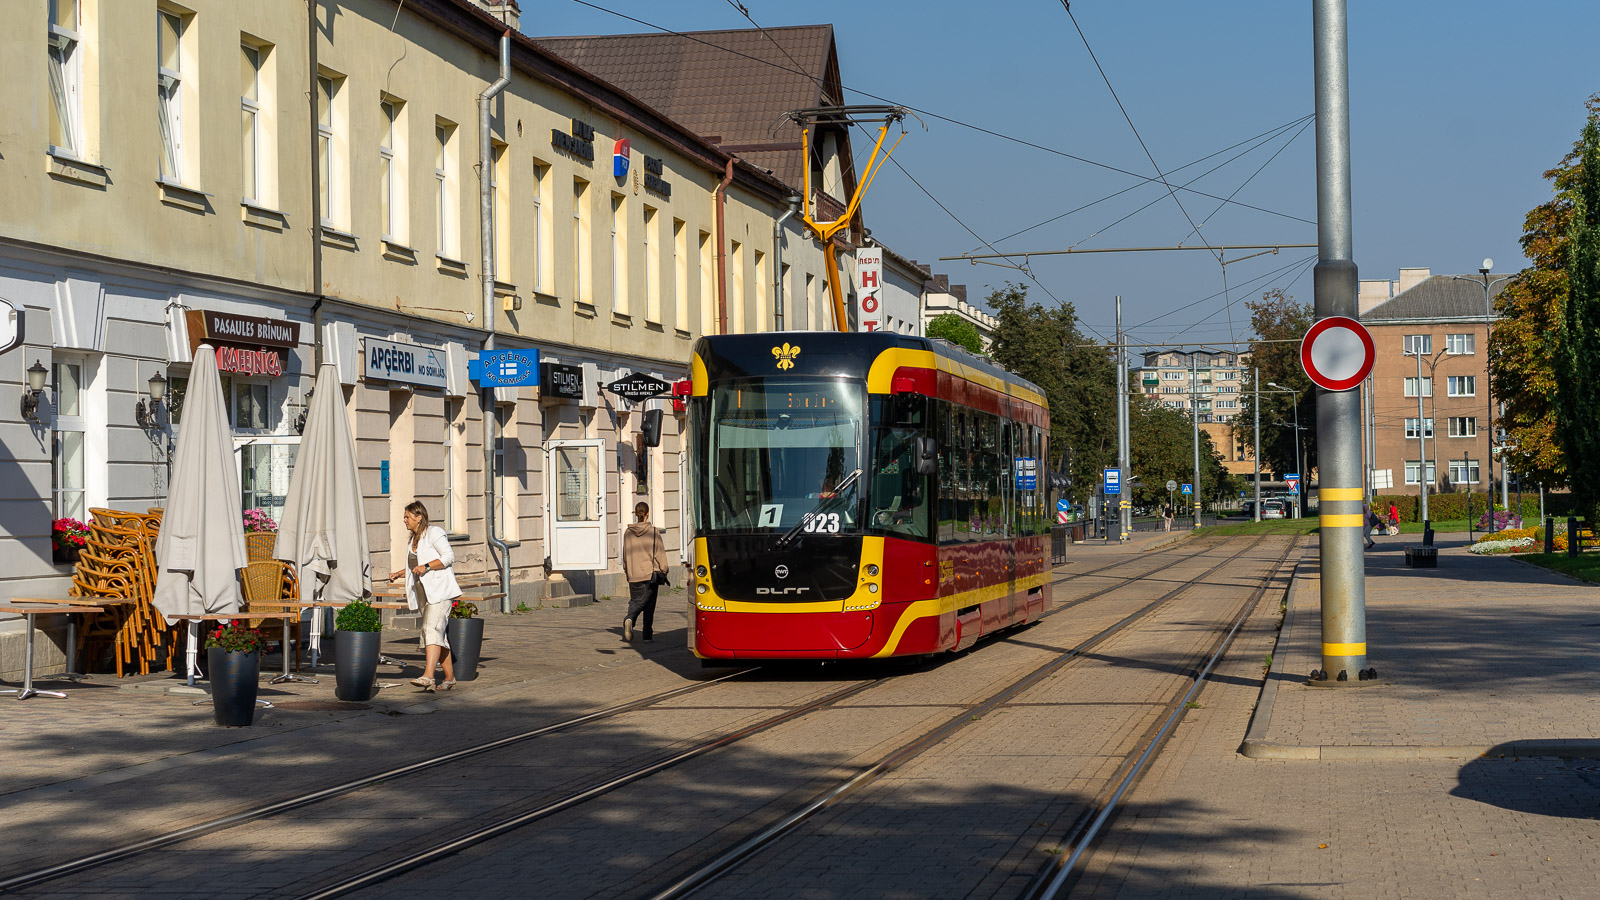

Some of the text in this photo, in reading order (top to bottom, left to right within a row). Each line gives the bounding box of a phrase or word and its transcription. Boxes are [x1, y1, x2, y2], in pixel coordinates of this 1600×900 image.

[214, 317, 292, 341] PASAULES BRĪNUMI
[220, 346, 282, 376] KAFEJNĪCA
[418, 364, 426, 376] NO
[486, 370, 531, 384] NO SOMIJAS
[553, 371, 579, 385] STILMEN
[613, 383, 664, 391] STILMEN
[765, 507, 777, 524] 1
[803, 512, 840, 533] 023
